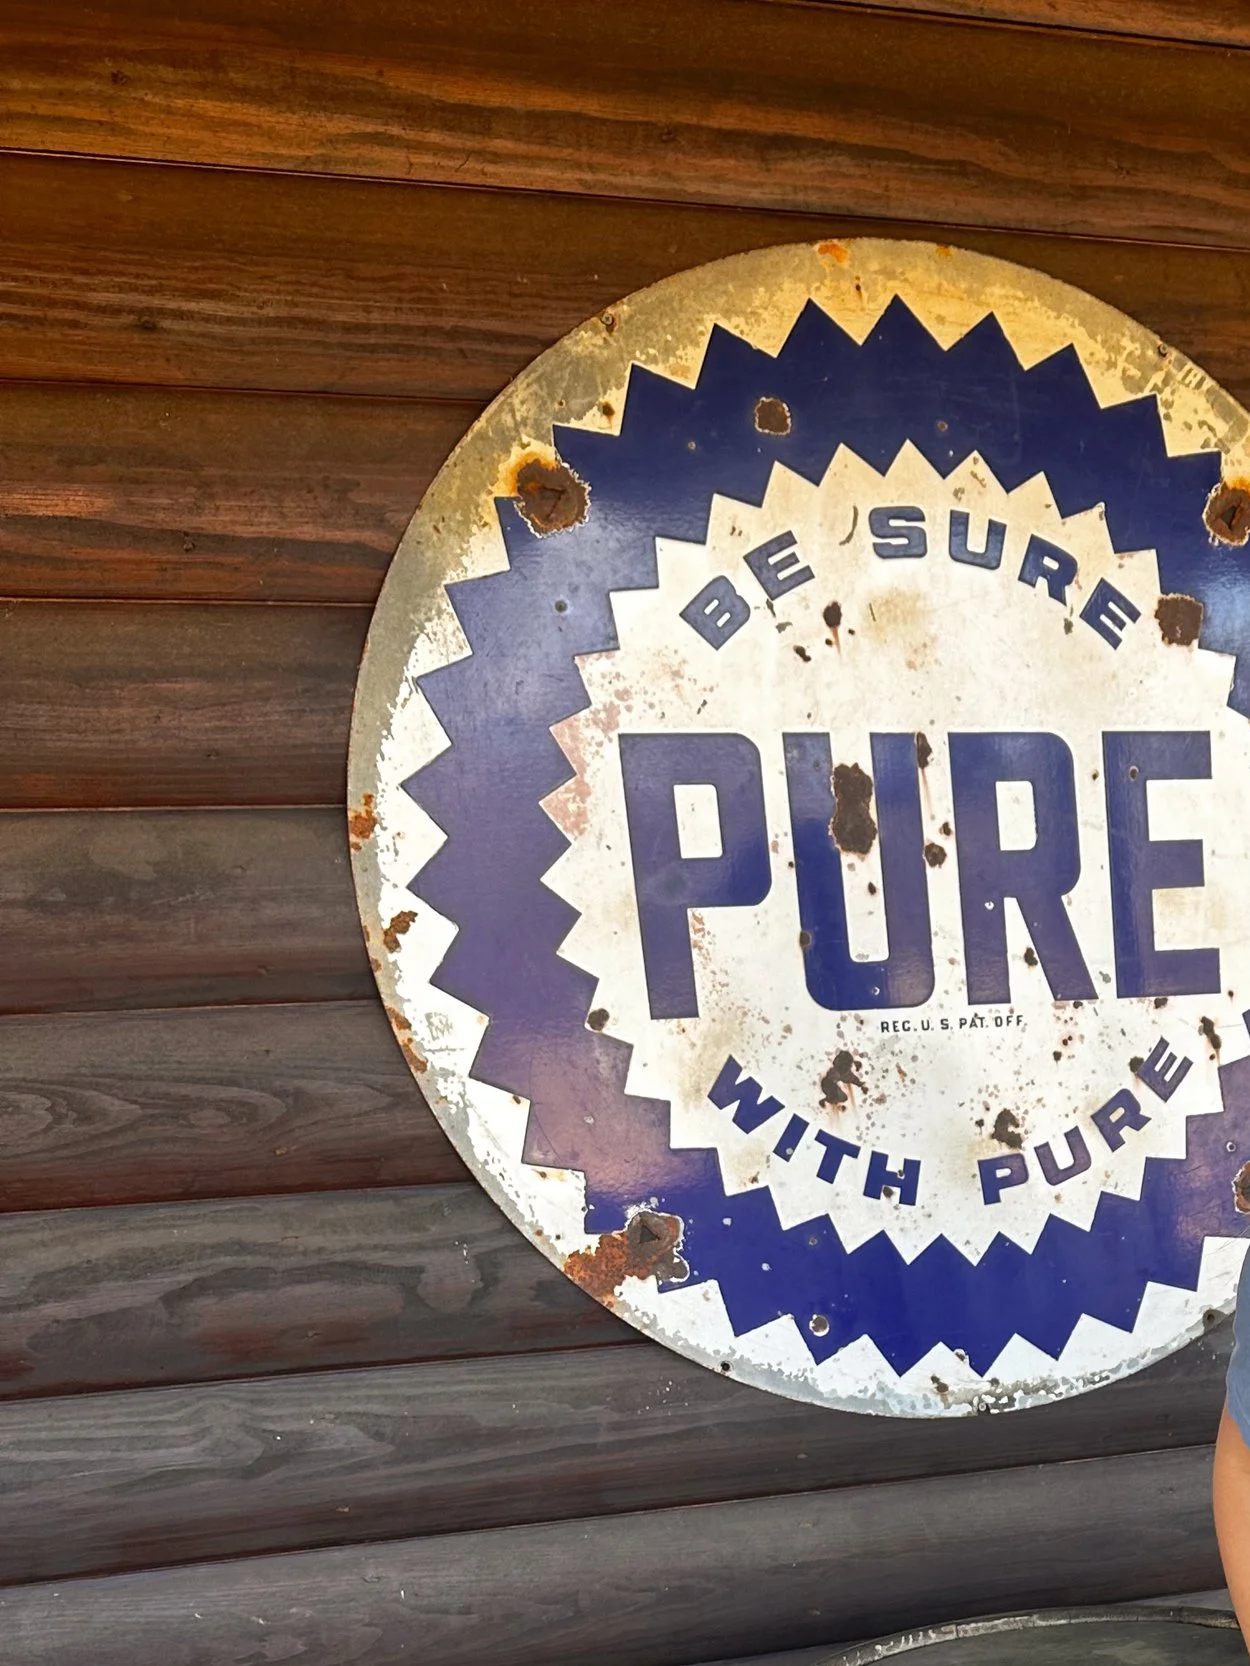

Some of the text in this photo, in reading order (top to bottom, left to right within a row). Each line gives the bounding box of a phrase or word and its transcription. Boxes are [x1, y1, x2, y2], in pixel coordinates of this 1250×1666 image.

[679, 505, 1142, 651] BE SURE
[618, 729, 1222, 1021] PURE
[880, 1020, 918, 1033] REG.
[959, 1016, 989, 1030] PAT.
[707, 1036, 1194, 1207] WITH PURE
